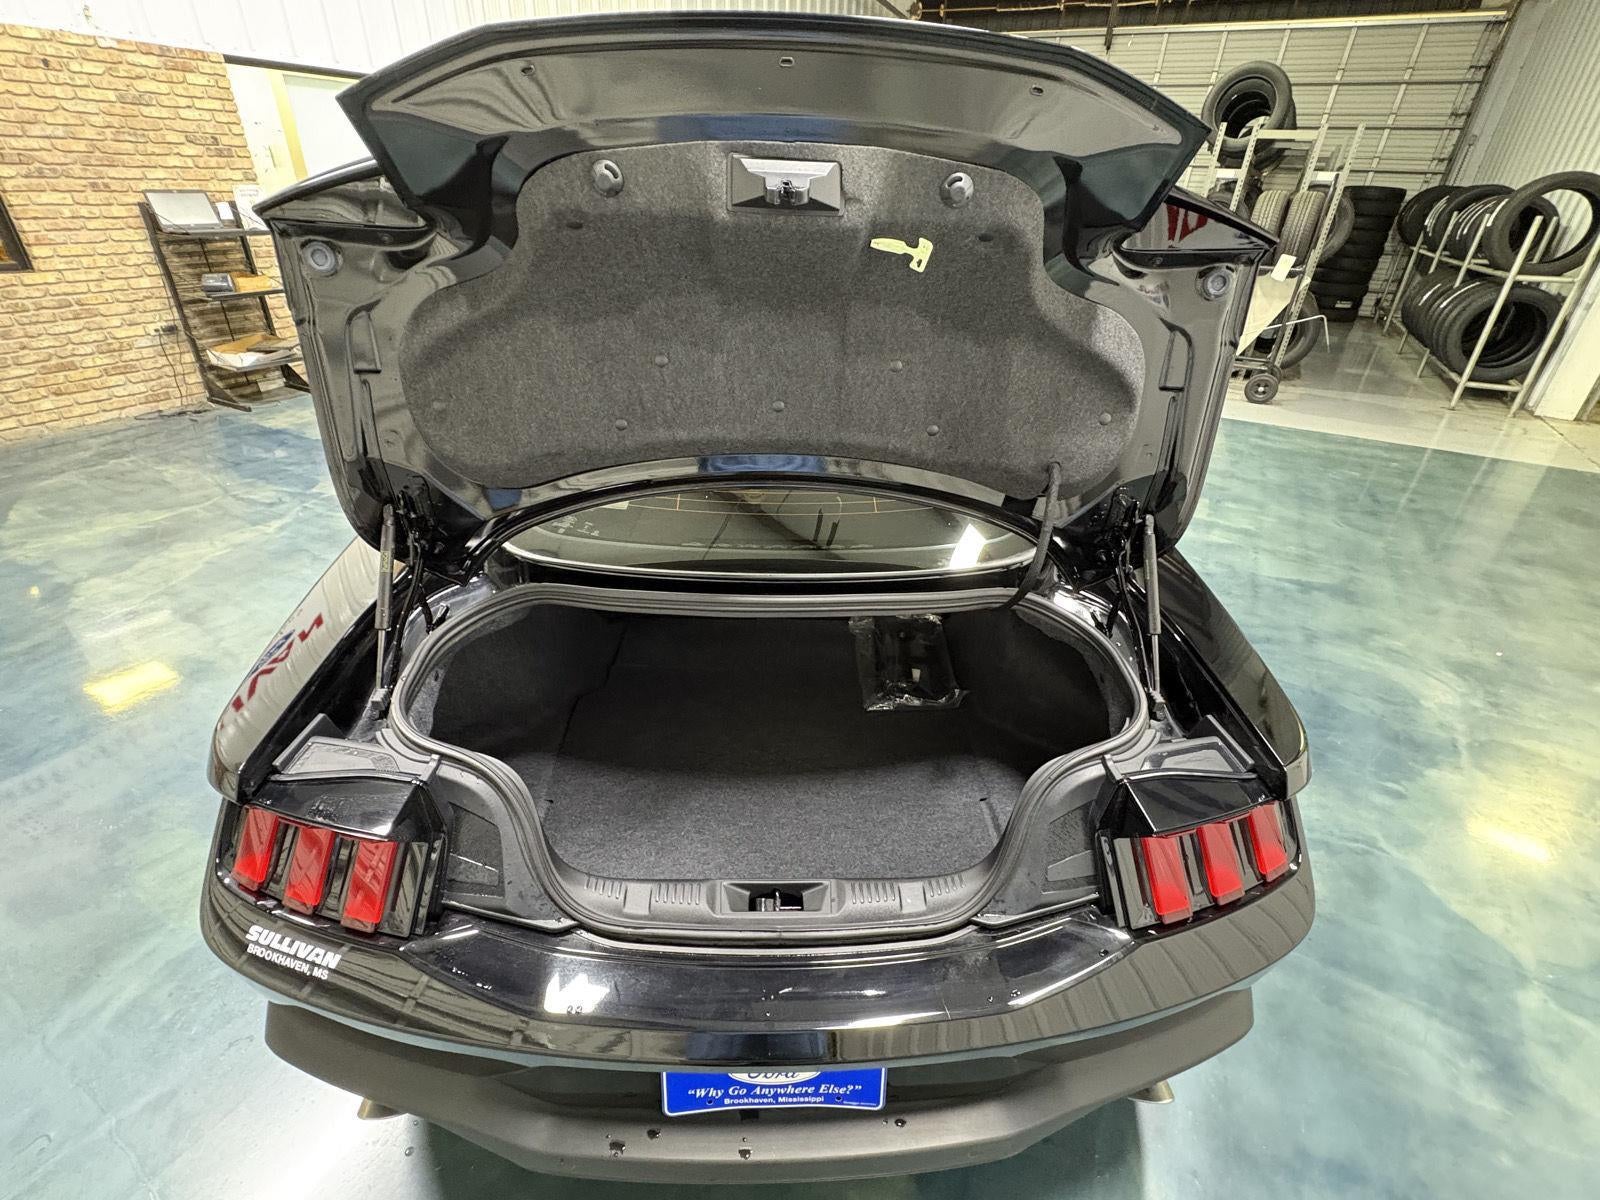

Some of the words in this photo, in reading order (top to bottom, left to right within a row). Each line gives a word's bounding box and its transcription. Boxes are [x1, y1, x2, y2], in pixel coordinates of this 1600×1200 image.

[245, 925, 342, 969] SULLIVAN
[246, 943, 311, 976] BROOKHAVEN,
[312, 966, 329, 980] MS
[724, 1097, 776, 1105] Brookhaven,
[728, 1085, 747, 1095] Go
[750, 1085, 815, 1097] Anywhere
